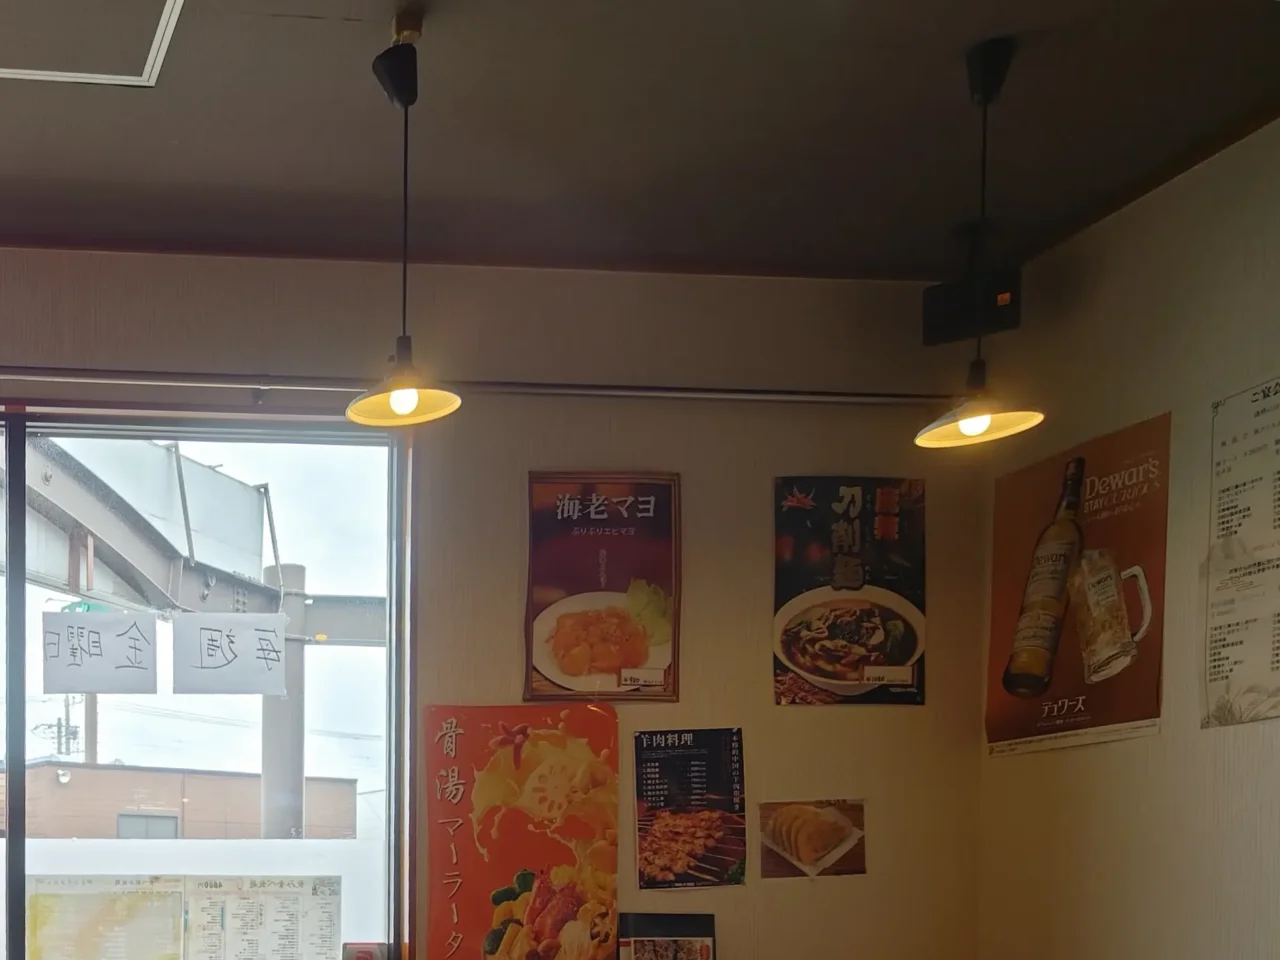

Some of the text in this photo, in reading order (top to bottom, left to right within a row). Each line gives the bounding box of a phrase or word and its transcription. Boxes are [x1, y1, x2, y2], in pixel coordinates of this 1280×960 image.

[1085, 457, 1160, 500] Dewar's
[555, 493, 656, 521] 海老マヨ
[1040, 695, 1087, 719] デュワーズ
[640, 732, 694, 748] 羊肉料理
